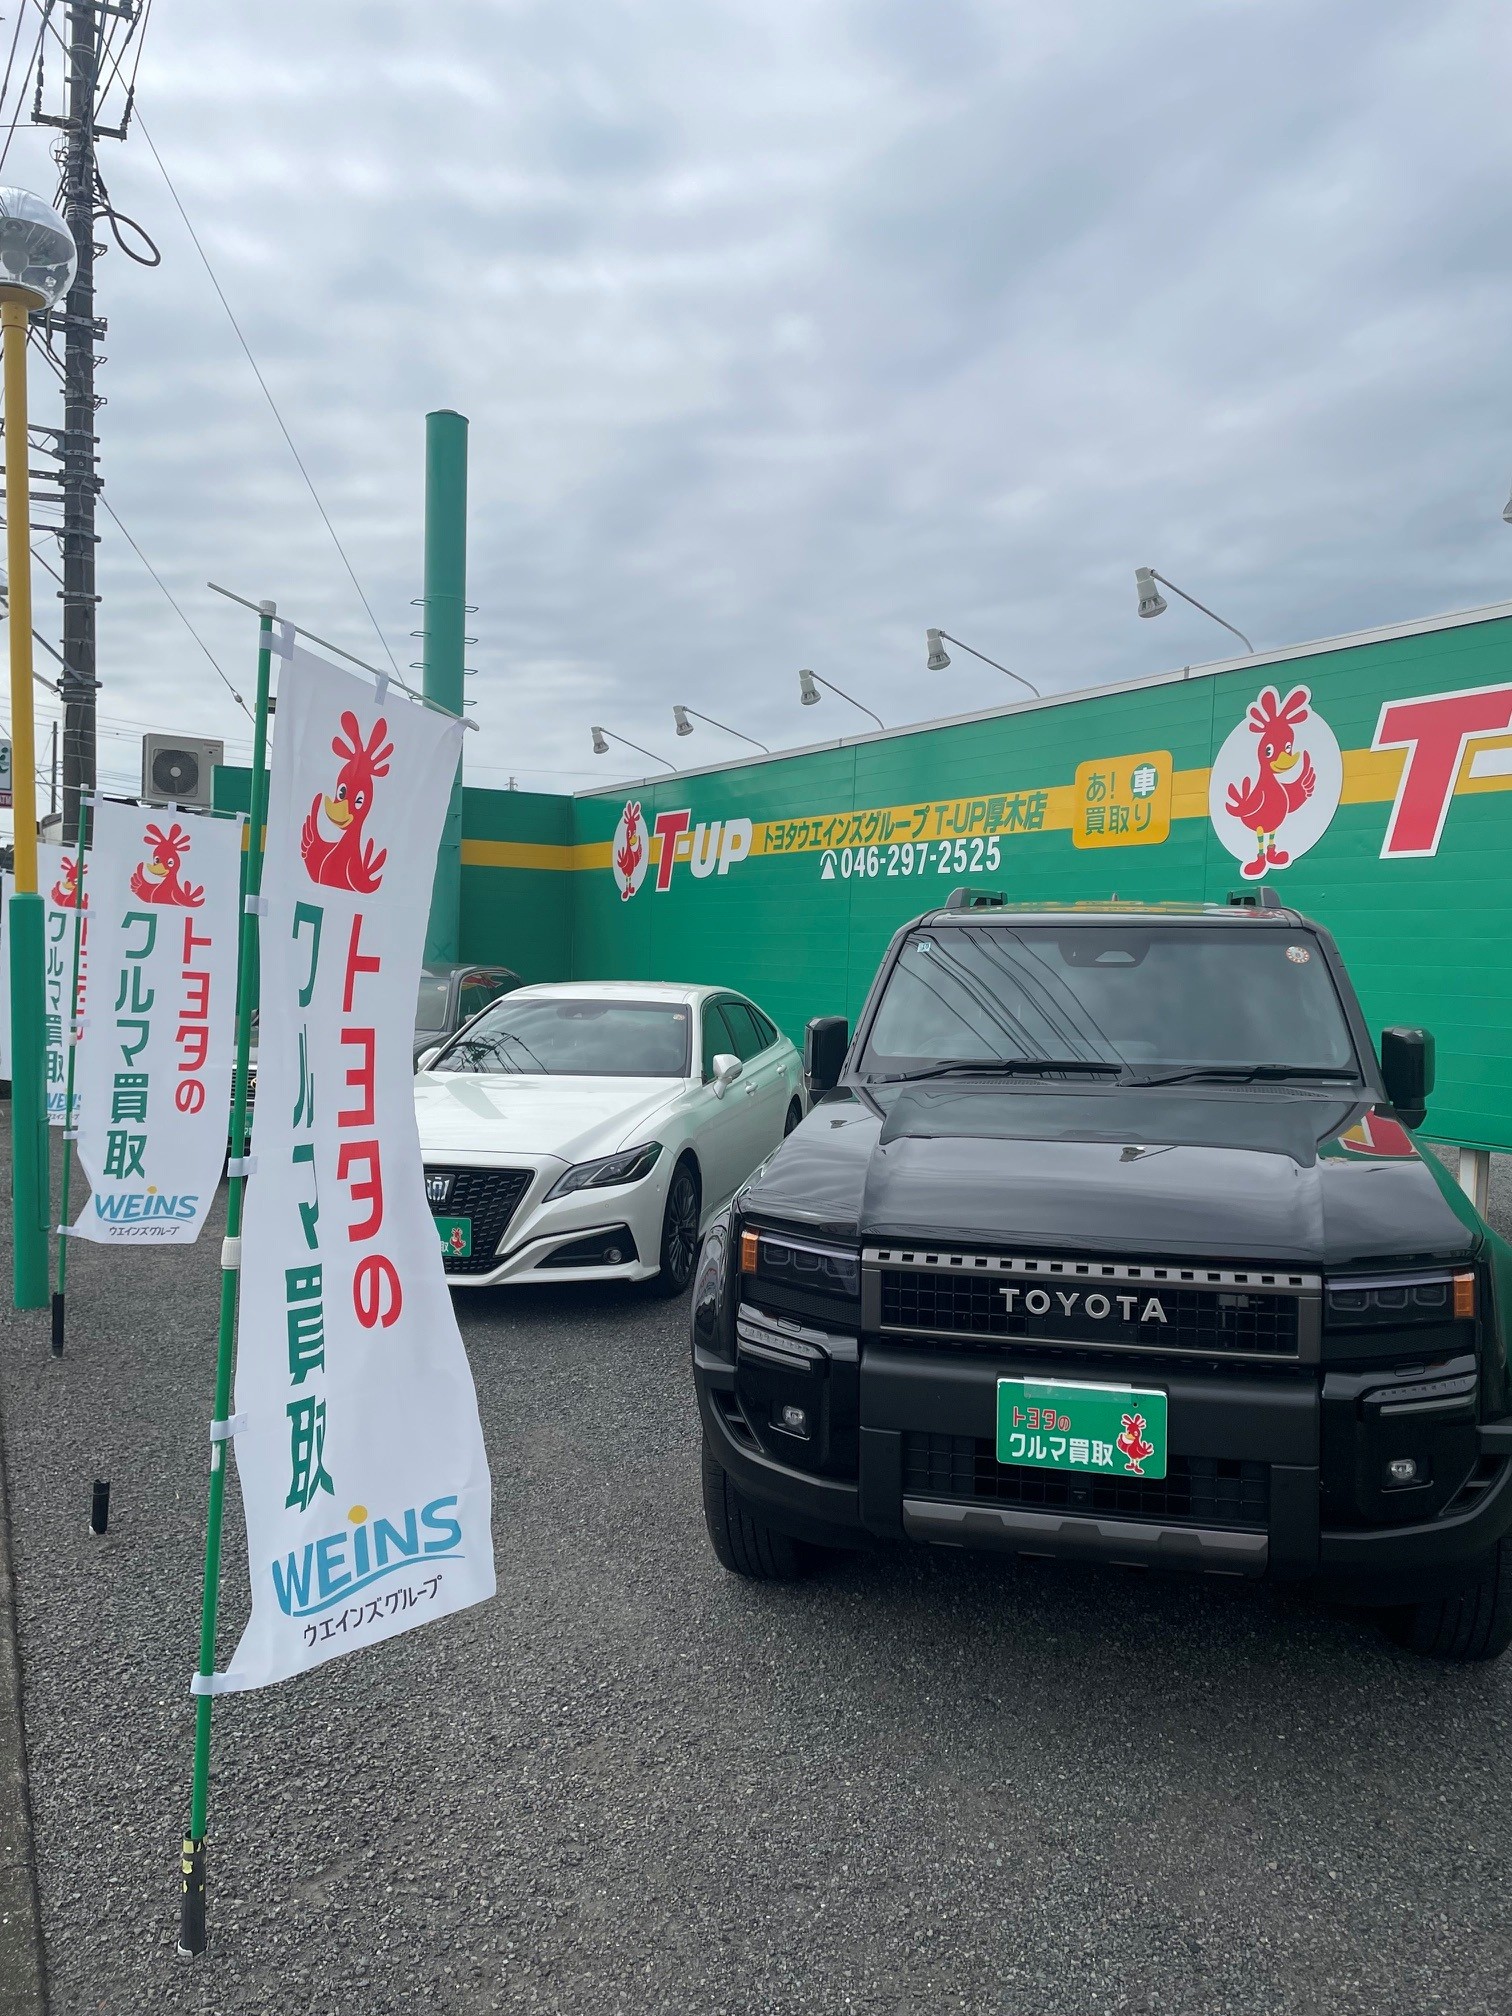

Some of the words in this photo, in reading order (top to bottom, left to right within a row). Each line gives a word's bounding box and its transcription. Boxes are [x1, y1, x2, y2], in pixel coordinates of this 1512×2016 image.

[763, 804, 931, 853] トヨタウエインズグループ
[935, 791, 1049, 836] T-UP厚木店
[1085, 802, 1152, 835] 買取り
[653, 808, 754, 893] T-UP
[840, 835, 1001, 879] 046-297-2525
[103, 911, 157, 1180] クルマ買取
[175, 916, 212, 1115] トヨタの
[336, 913, 403, 1329] トヨタの
[109, 1226, 180, 1236] ウエインズグループ
[284, 900, 336, 1514] クルマ買取
[999, 1287, 1168, 1323] TOYOTA
[1013, 1406, 1071, 1431] トヨタの
[1009, 1433, 1113, 1467] クルマ買取
[303, 1575, 443, 1647] ウエインズグループ
